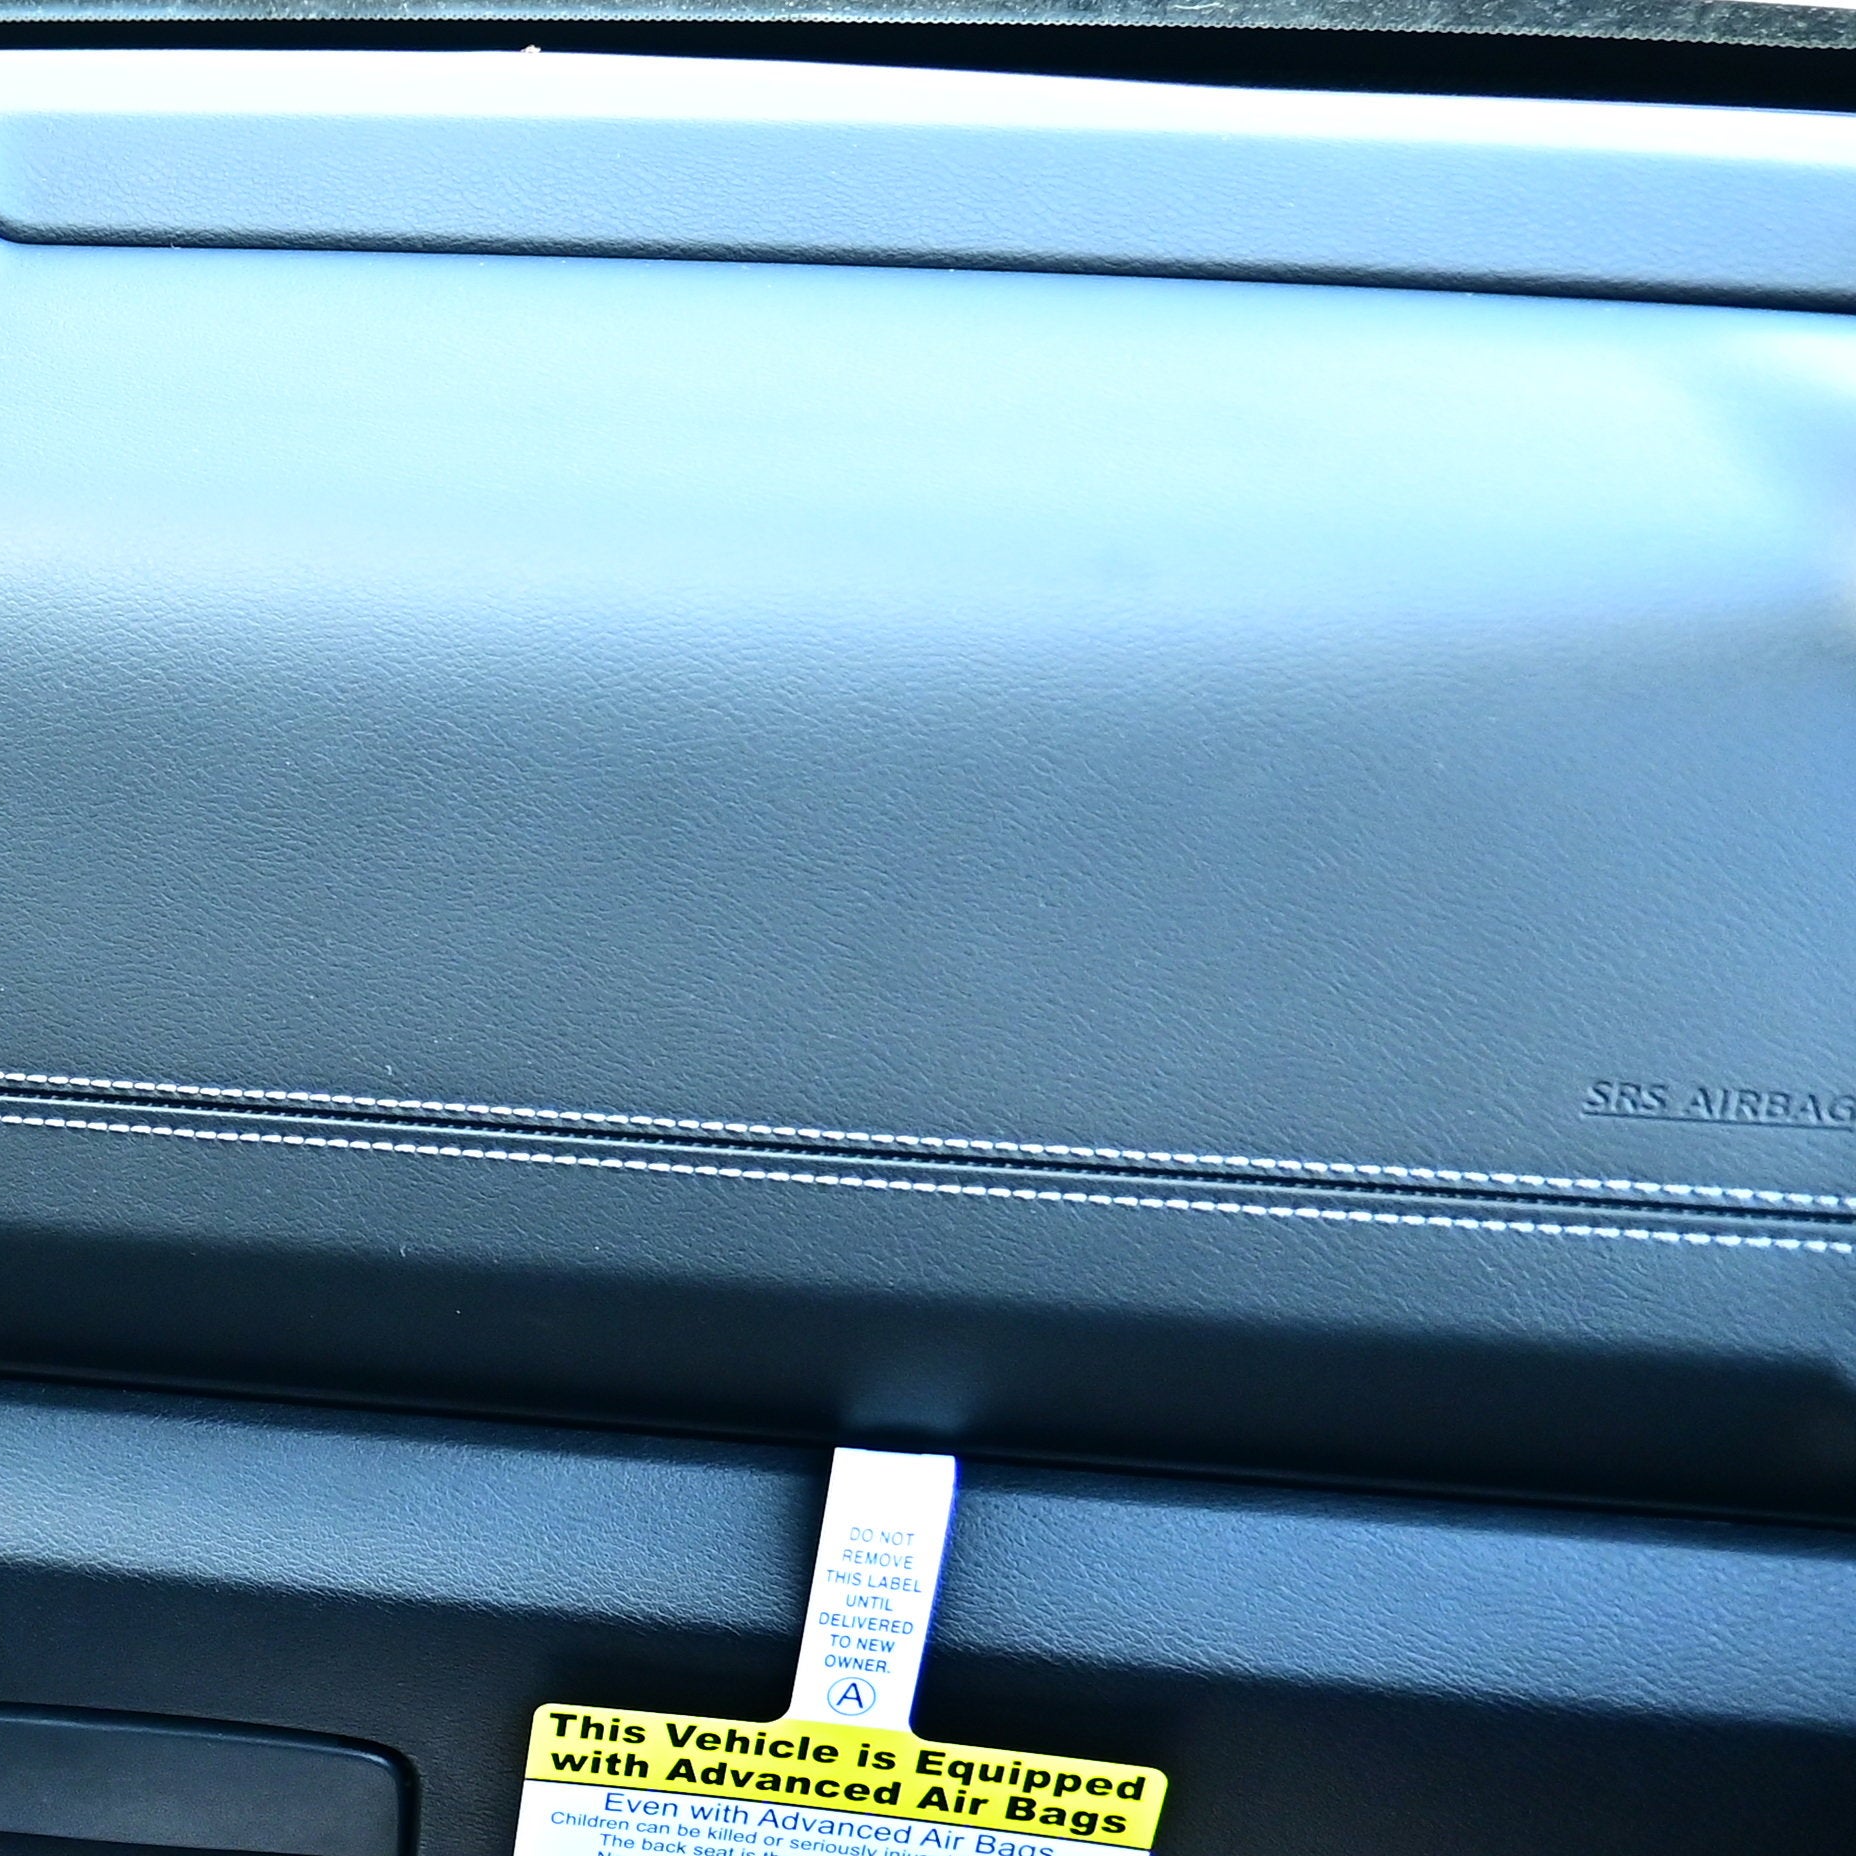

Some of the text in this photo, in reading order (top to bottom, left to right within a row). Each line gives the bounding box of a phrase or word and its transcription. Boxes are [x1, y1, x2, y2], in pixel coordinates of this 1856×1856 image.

[1584, 1080, 1856, 1123] SRS AIRBAG
[850, 1526, 915, 1546] DO NOT
[842, 1548, 913, 1570] REMOVE
[827, 1569, 922, 1593] THIS LABEL
[846, 1594, 893, 1612] UNTIL
[819, 1611, 914, 1635] DELIVERED
[830, 1634, 895, 1654] TO NEW
[824, 1654, 891, 1674] OWNER.
[836, 1682, 863, 1709] A
[550, 1712, 1146, 1801] This Vehicle is Equipped
[550, 1750, 1127, 1836] with Advanced Air Bags
[550, 1811, 629, 1831] Children
[636, 1822, 670, 1835] can
[678, 1823, 701, 1838] be
[707, 1826, 758, 1845] killed
[763, 1834, 783, 1847] or
[604, 1792, 678, 1817] Even
[690, 1803, 749, 1825] with
[757, 1808, 912, 1844] Advanced
[919, 1828, 965, 1851] Air
[599, 1833, 635, 1850] The
[641, 1837, 686, 1855] back
